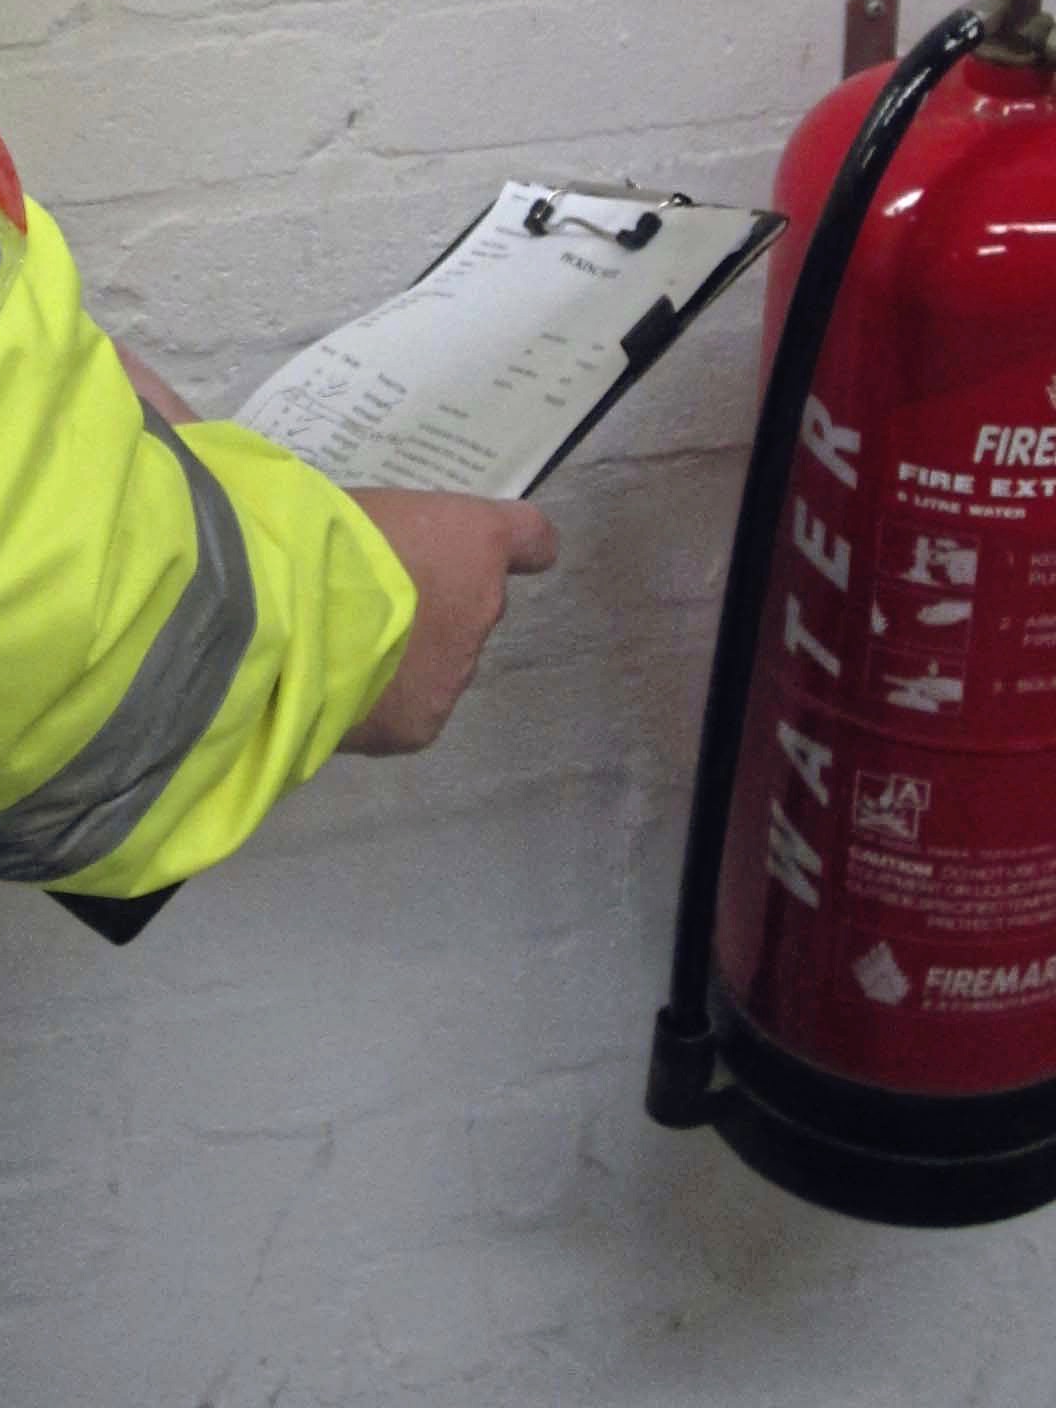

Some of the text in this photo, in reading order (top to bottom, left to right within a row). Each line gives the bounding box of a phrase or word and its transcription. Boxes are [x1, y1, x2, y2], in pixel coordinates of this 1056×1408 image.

[898, 461, 975, 495] FIRE
[914, 494, 961, 515] LITRE
[968, 503, 1027, 520] WATER
[766, 393, 861, 910] WATER
